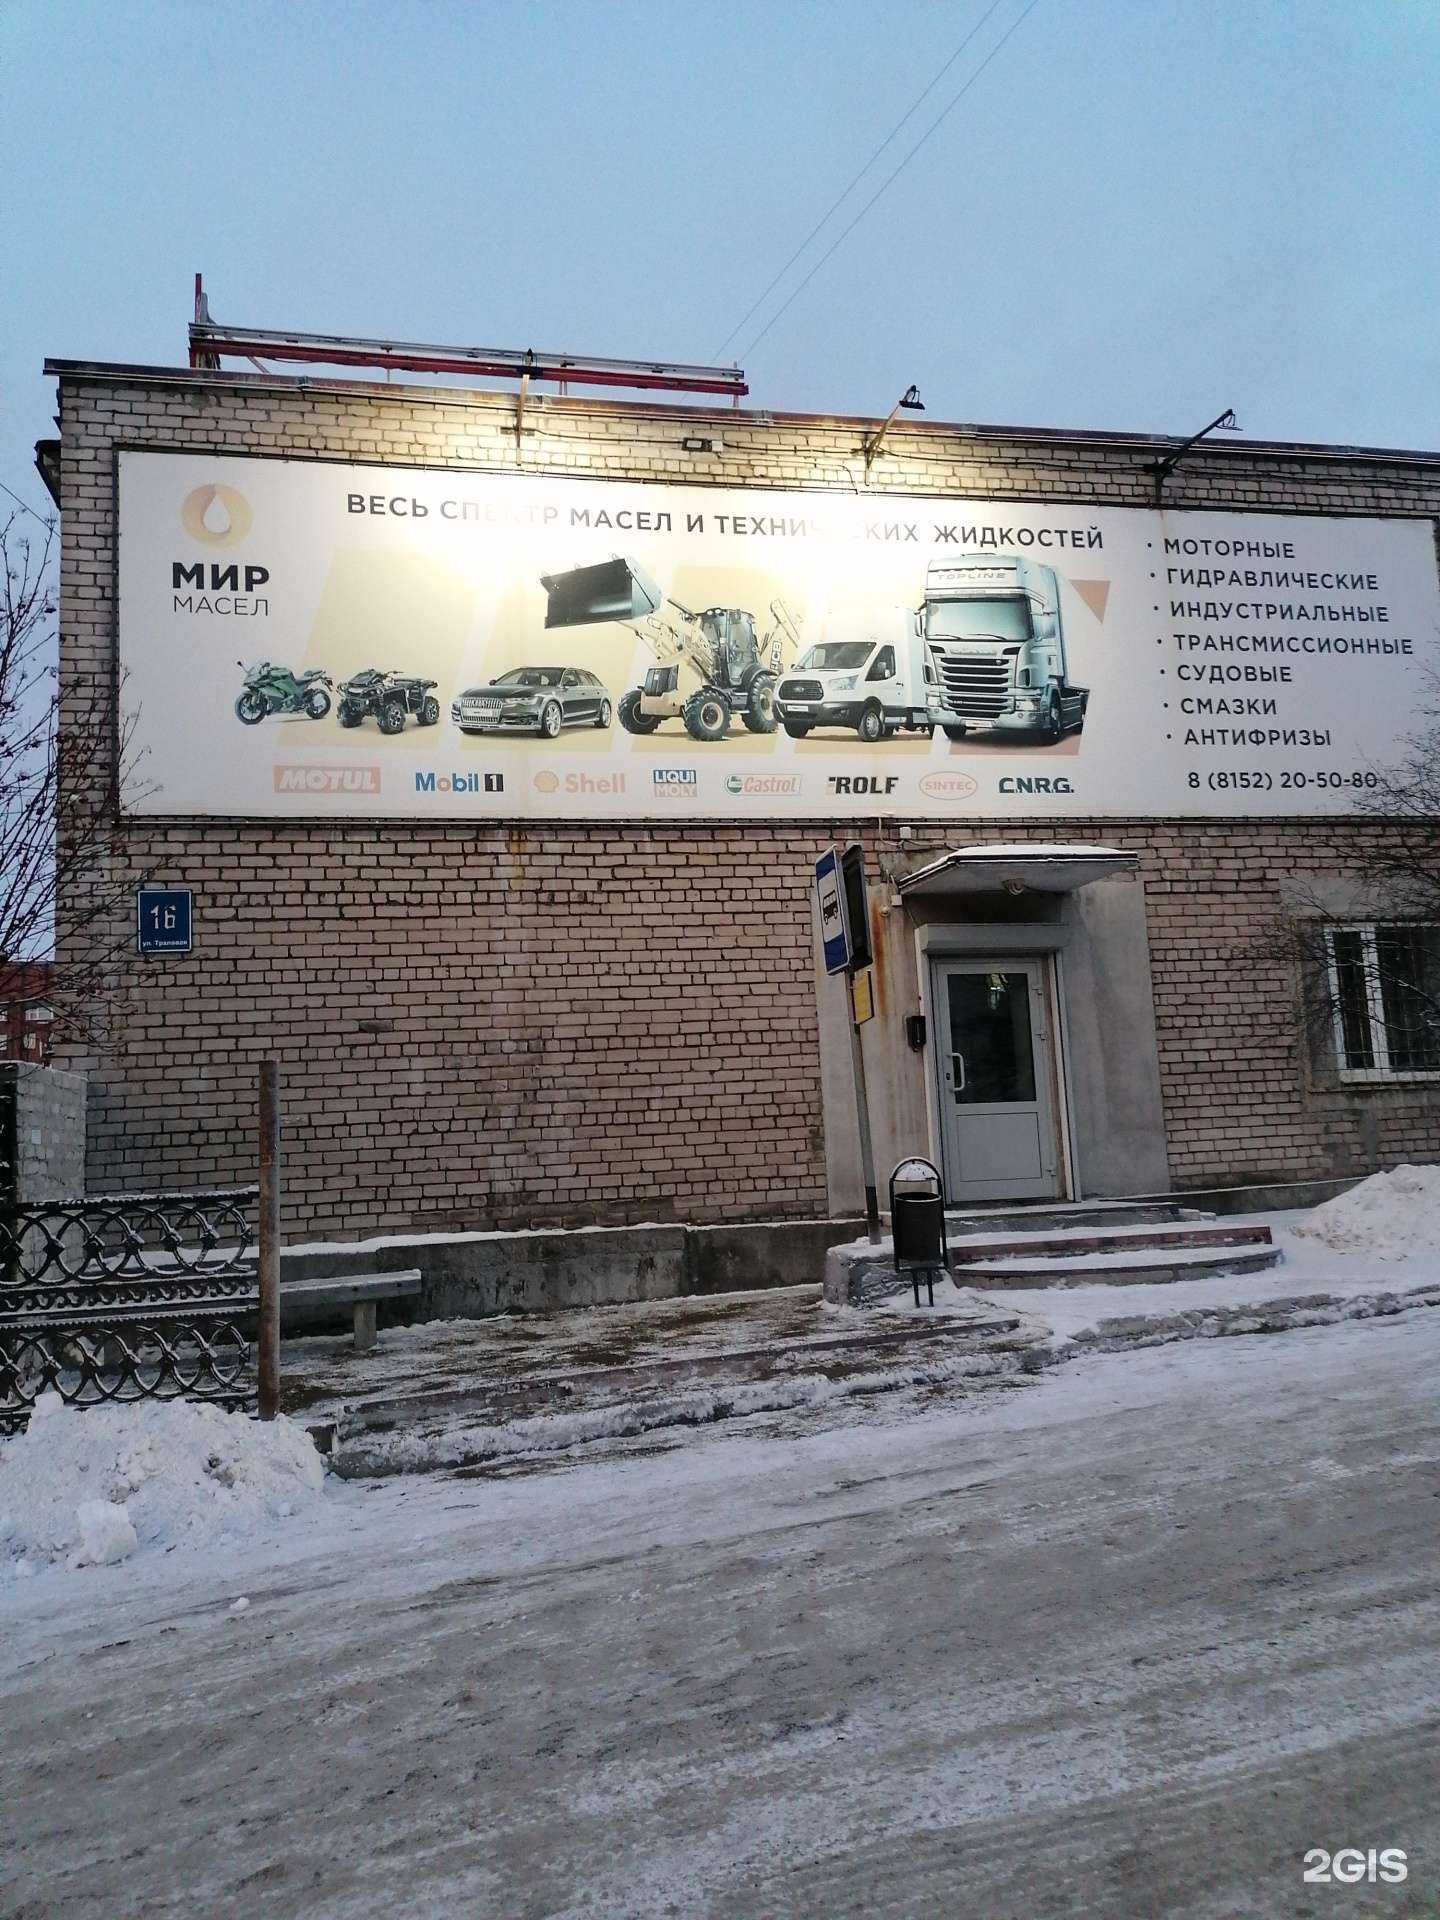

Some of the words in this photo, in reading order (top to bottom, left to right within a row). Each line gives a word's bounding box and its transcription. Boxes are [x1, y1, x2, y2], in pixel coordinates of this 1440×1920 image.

[347, 492, 428, 518] ВЕСЬ
[570, 507, 673, 532] МАСЕЛ
[686, 513, 704, 533] И
[714, 514, 919, 542] ТЕХНИКИХ
[934, 524, 1103, 549] ЖИДКОСТЕЙ
[1164, 537, 1296, 559] МОТОРНЫЕ
[172, 561, 270, 592] МИР
[1167, 567, 1379, 590] ГИДРАВЛИЧЕСКИЕ
[173, 595, 268, 617] МАСЕЛ
[1170, 601, 1389, 623] ИНДУСТРИАЛЬНЫЕ
[1173, 634, 1414, 655] ТРАНСМИССИОННЫЕ
[1177, 664, 1293, 684] СУДОВЫЕ
[1180, 698, 1277, 715] СМАЗКИ
[1184, 729, 1332, 747] АНТИФРИЗЫ
[278, 769, 377, 791] MOTUL
[415, 772, 479, 792] Mobil
[565, 773, 626, 794] Shell
[654, 770, 696, 784] LIQUI
[744, 775, 796, 793] Castrol
[829, 776, 899, 795] ROLF
[925, 779, 973, 792] SINTEC
[1188, 772, 1200, 788] 8
[1208, 772, 1274, 790] (8152)
[1280, 772, 1379, 789] 20-50-80
[655, 784, 697, 798] MOLY
[150, 904, 177, 929] 16
